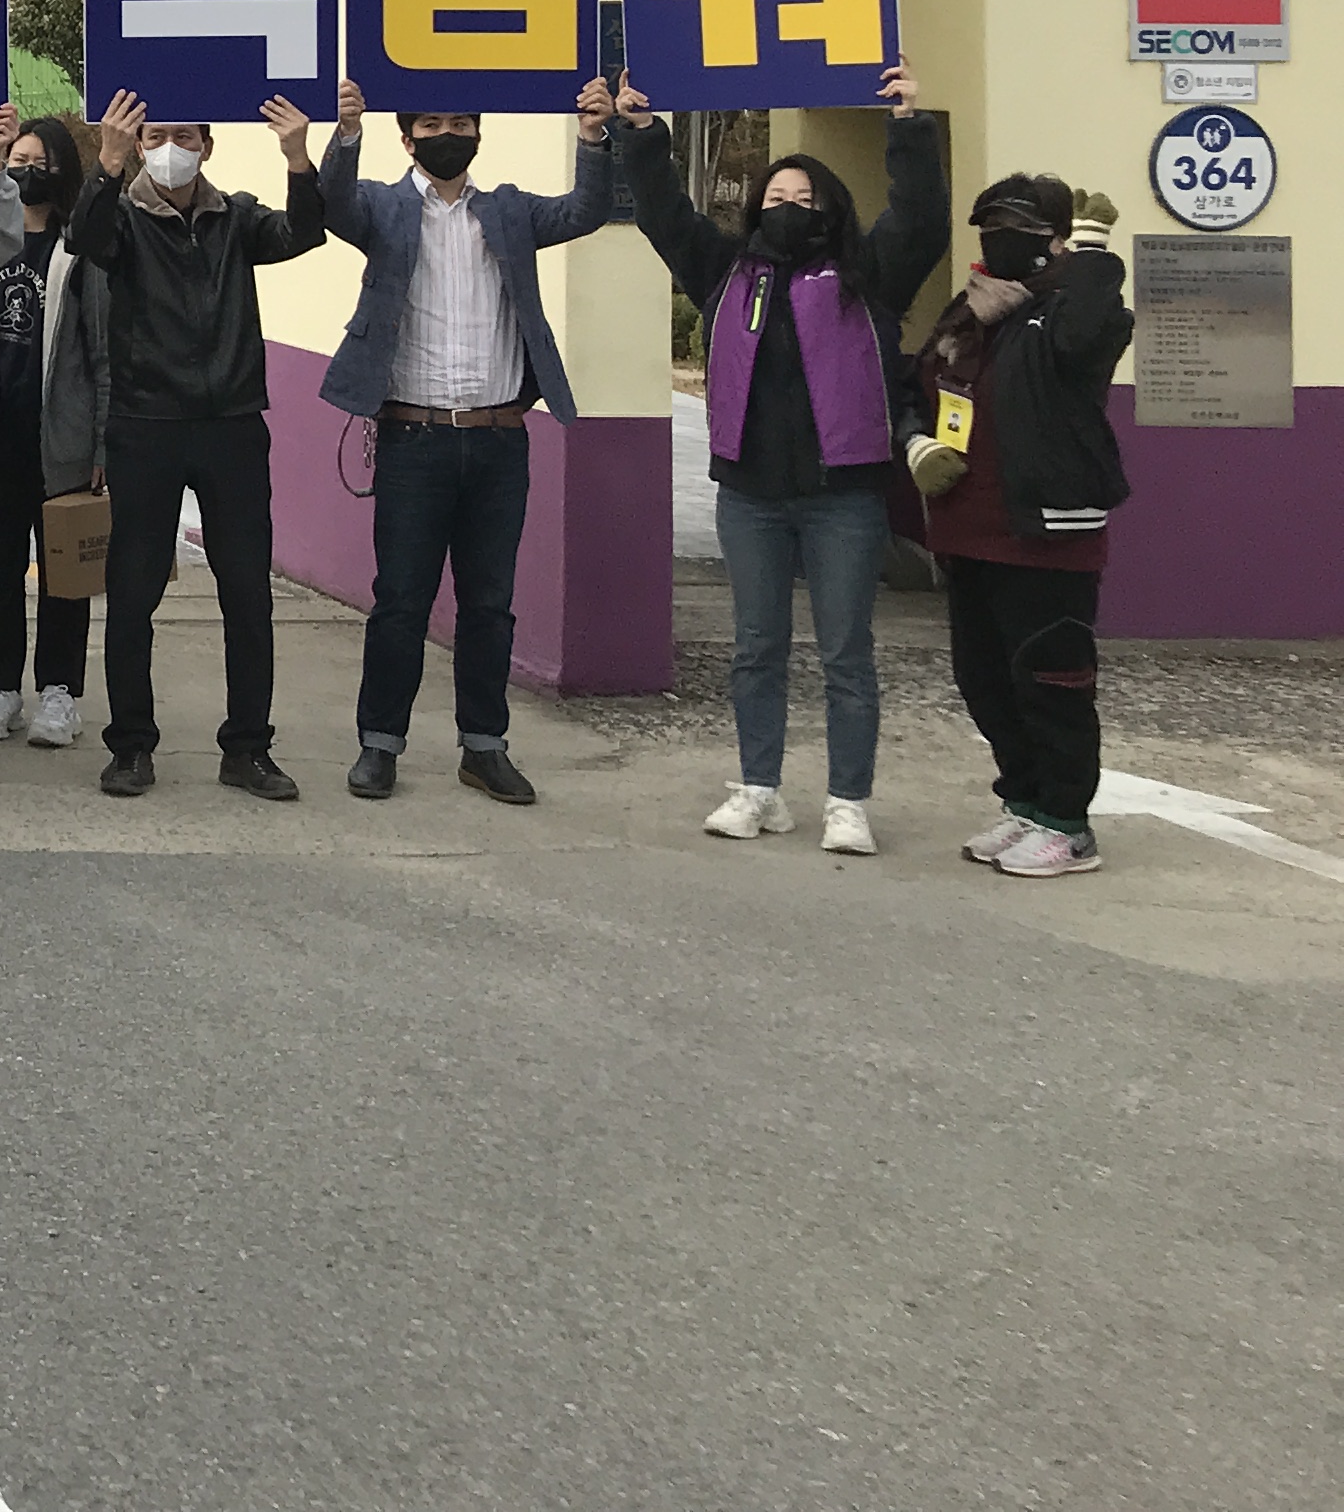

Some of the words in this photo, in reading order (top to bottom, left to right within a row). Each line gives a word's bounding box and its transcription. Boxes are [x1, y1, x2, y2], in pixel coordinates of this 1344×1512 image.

[1138, 30, 1236, 54] SECOM
[1172, 156, 1256, 191] 364
[1194, 196, 1237, 210] 삼가로
